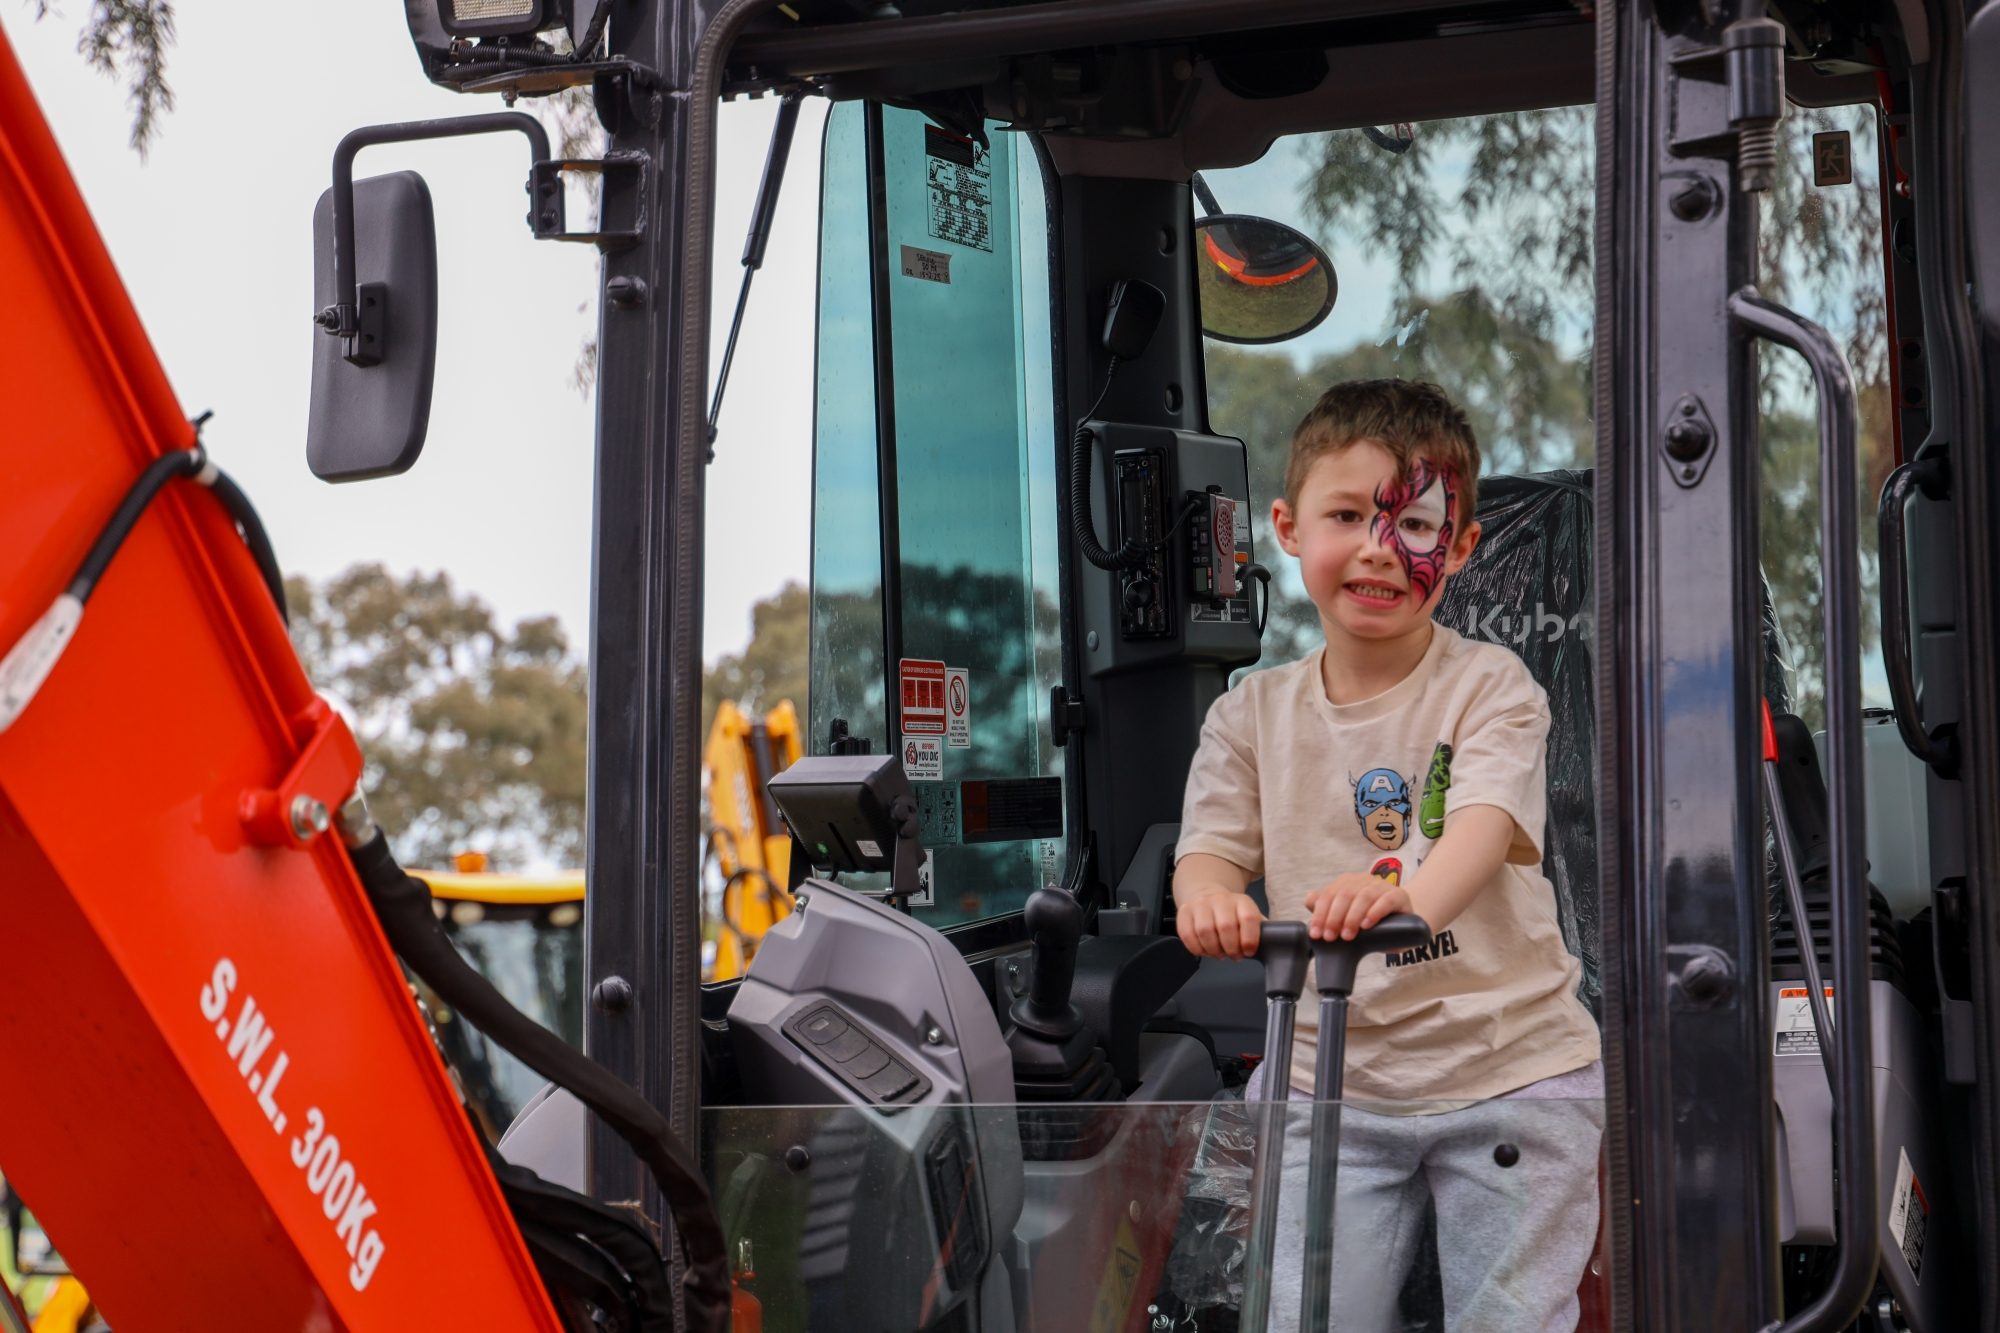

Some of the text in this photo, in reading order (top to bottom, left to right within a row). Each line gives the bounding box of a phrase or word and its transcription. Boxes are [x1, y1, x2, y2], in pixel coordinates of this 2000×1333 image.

[918, 751, 939, 762] YOU DIG
[1369, 775, 1395, 793] A
[1386, 929, 1459, 968] MARVEL
[200, 957, 386, 1292] S.W.L. 300Kg
